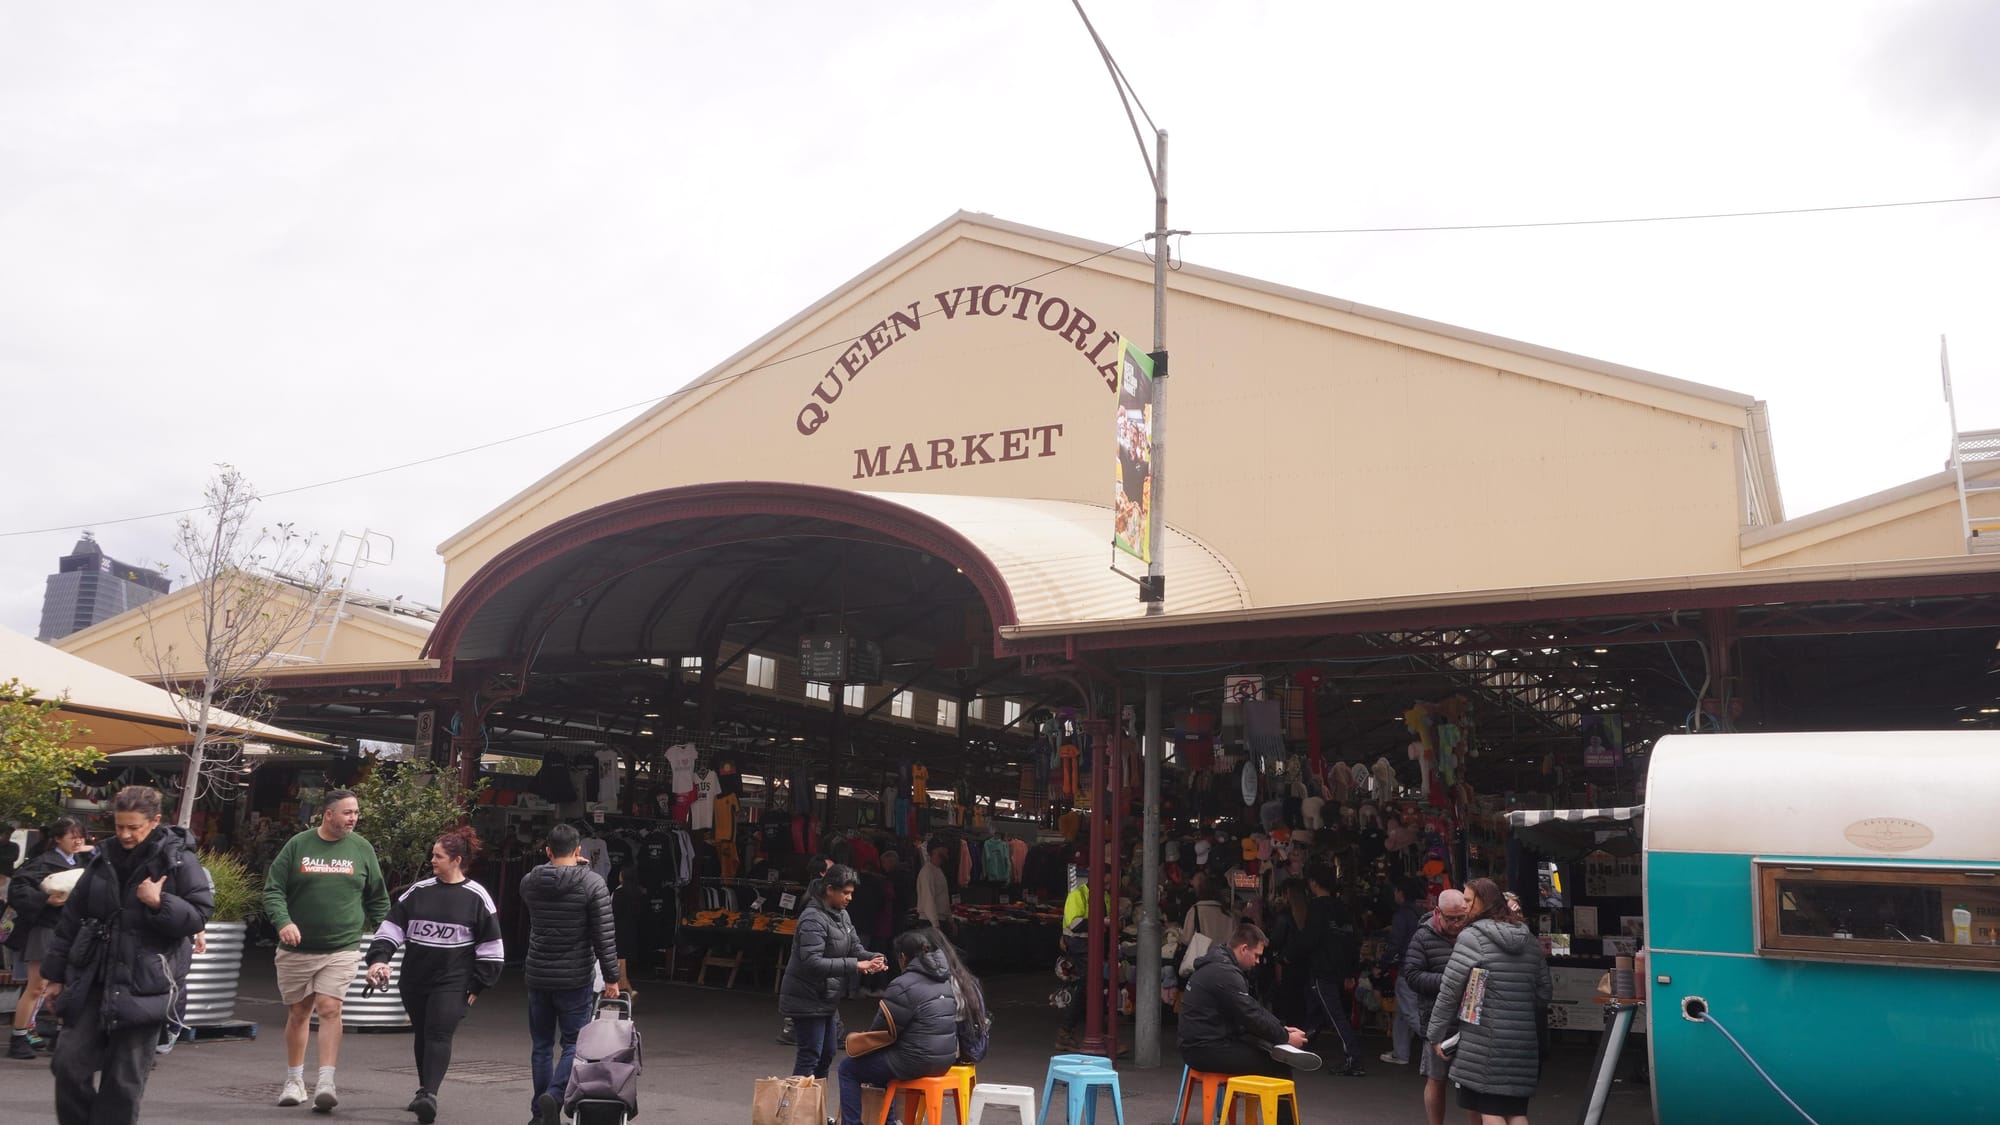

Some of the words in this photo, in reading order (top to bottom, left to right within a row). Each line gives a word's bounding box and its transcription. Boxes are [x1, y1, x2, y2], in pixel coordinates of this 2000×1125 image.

[796, 301, 921, 436] QUEEN
[852, 423, 1063, 479] MARKET
[302, 856, 325, 866] BALL
[331, 859, 354, 867] PARK
[304, 864, 353, 874] warehouse
[413, 922, 455, 939] LSKD
